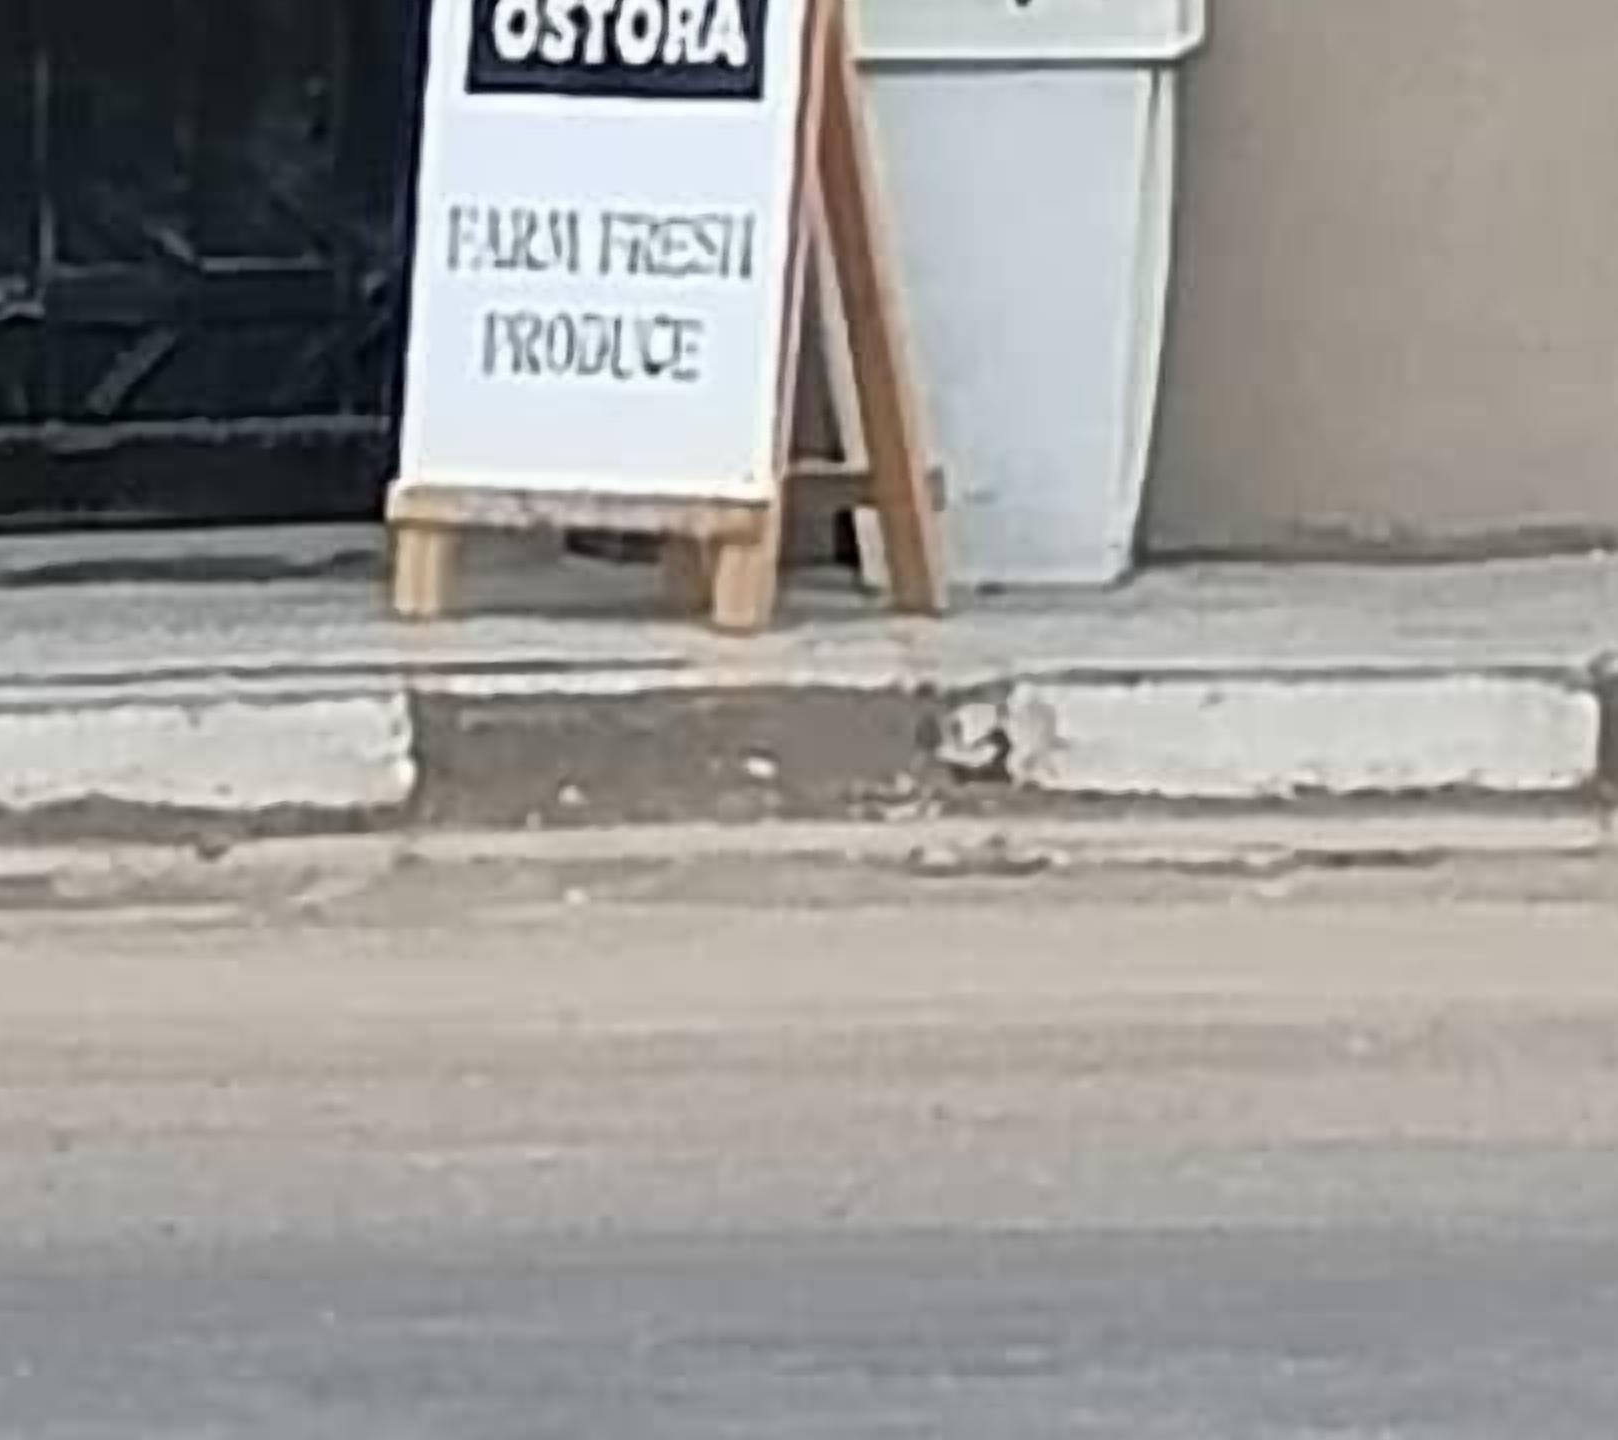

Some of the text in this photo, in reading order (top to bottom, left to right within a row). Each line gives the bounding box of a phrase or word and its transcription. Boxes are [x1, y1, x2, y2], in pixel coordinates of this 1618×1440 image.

[447, 204, 756, 279] FARM FRESH
[482, 310, 703, 381] PRODUCE
